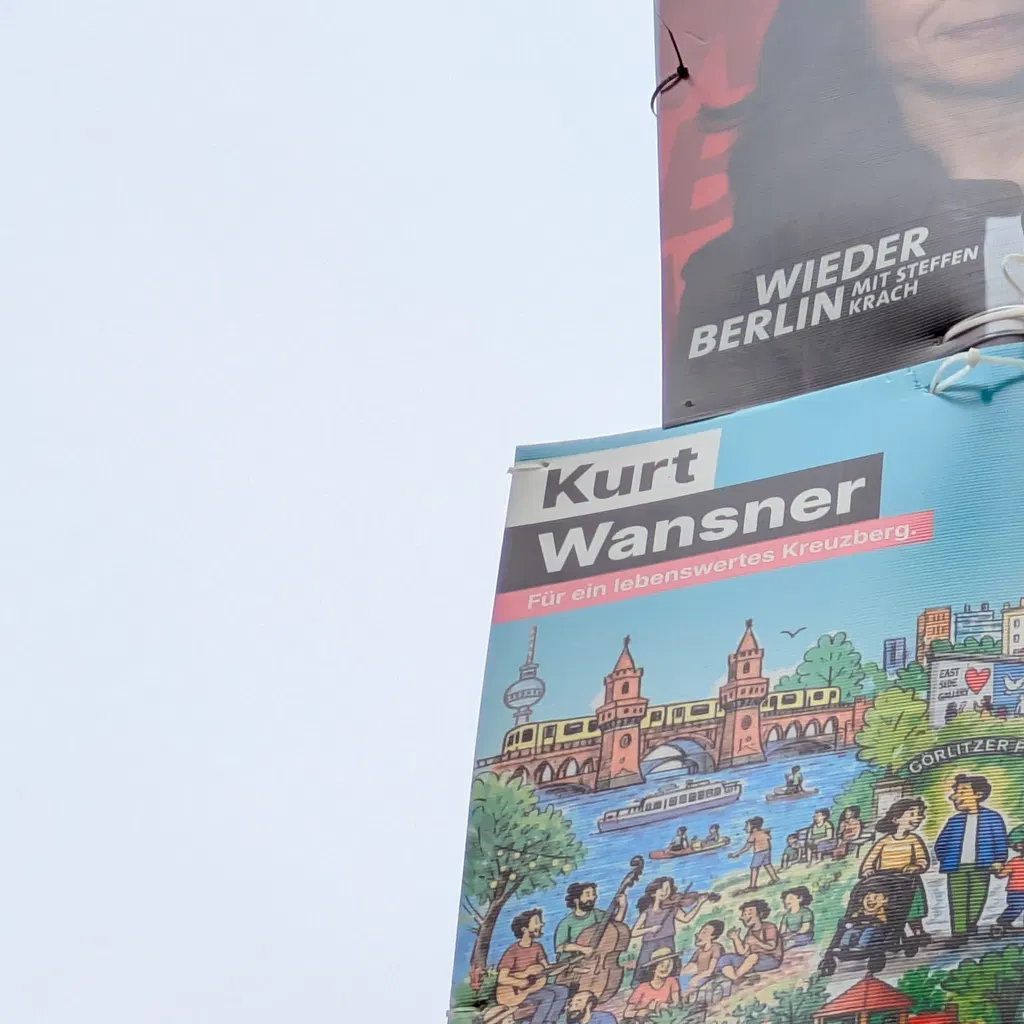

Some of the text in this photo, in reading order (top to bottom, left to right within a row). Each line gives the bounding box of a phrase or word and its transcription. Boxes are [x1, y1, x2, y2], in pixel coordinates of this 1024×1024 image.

[756, 226, 929, 306] WIEDER
[851, 245, 979, 297] MIT STEFFEN
[688, 286, 845, 359] BERLIN
[849, 280, 918, 315] KRACH
[541, 447, 699, 509] Kurt
[538, 477, 866, 573] Wansner
[527, 523, 917, 610] Für ein lebenswertes Kreuzberg.
[939, 667, 960, 679] EAST
[908, 739, 1009, 774] GÖRLITZER
